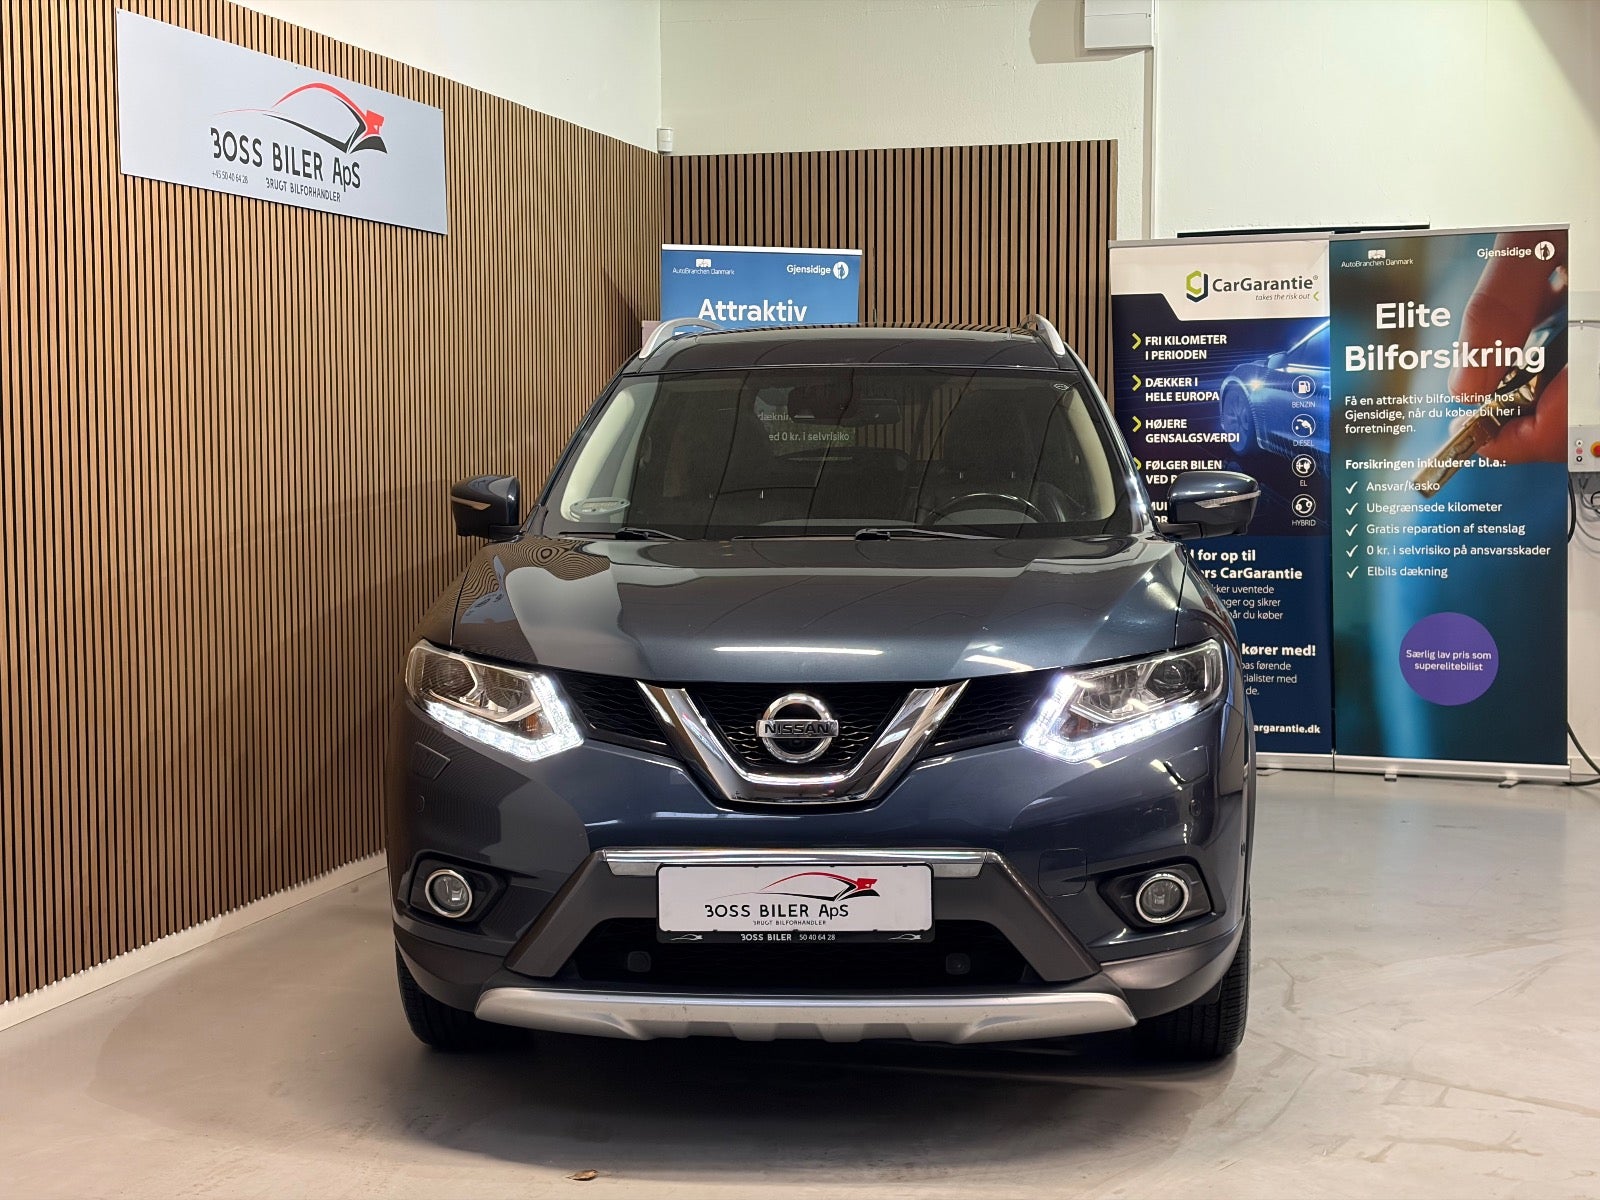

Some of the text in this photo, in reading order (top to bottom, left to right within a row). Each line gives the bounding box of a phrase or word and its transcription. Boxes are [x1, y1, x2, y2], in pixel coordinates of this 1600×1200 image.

[272, 142, 324, 182] BILER
[332, 157, 361, 192] ApS
[290, 183, 341, 202] BILFORHANDLER
[1476, 247, 1532, 260] Gjensidige
[1341, 258, 1414, 268] AutoBranchen Danmark
[672, 267, 734, 276] AutoBranchen Danmark
[786, 265, 831, 276] Gjensidige
[698, 298, 808, 322] Attraktiv
[1376, 301, 1450, 330] Elite
[1145, 334, 1228, 346] FRI KILOMETER
[1145, 350, 1208, 360] I PERIODEN
[1345, 339, 1545, 372] Bilforsikring
[1145, 377, 1198, 388] DÆKKER I
[1145, 391, 1220, 402] HELE EUROPA
[1344, 393, 1515, 406] Få en attraktiv bilforsikring hos
[1292, 401, 1316, 409] BENZIN
[1344, 406, 1521, 422] Gjensidige, når du køber bil her i
[1145, 419, 1188, 430] HØJERE
[1344, 424, 1416, 435] forretningen.
[768, 431, 780, 441] ed
[782, 432, 788, 441] 0
[790, 431, 800, 441] kr.
[808, 431, 850, 441] selvrisiko
[1145, 432, 1240, 444] GENSALGSVÆRDI
[1145, 460, 1222, 470] FØLGER BILEN
[1345, 458, 1506, 471] Forsikringen inkluderer bl.a.:
[1145, 474, 1169, 484] VED
[1366, 480, 1441, 492] Ansvar/kasko
[1366, 502, 1503, 514] Ubegrænsede kilometer
[1366, 524, 1526, 536] Gratis reparation af stenslag
[1366, 545, 1374, 556] 0
[1376, 545, 1390, 556] kr.
[1399, 545, 1450, 556] selvrisiko
[1453, 544, 1467, 557] på
[1470, 545, 1552, 556] ansvarsskader
[1197, 549, 1218, 561] for
[1220, 552, 1238, 564] op
[1241, 549, 1256, 561] til
[1202, 567, 1303, 580] rs CarGarantie
[1367, 566, 1448, 579] Elbils dækning
[1232, 585, 1274, 594] uventede
[1242, 600, 1255, 608] og
[1258, 598, 1281, 607] sikrer
[1242, 610, 1256, 620] du
[1257, 610, 1284, 620] køber
[1241, 643, 1316, 656] kører med!
[1406, 650, 1436, 660] Særlig
[1438, 650, 1450, 659] lav
[1452, 651, 1470, 660] pris
[1256, 661, 1292, 671] førende
[1414, 662, 1483, 671] superelitebilist
[1276, 674, 1298, 684] med
[764, 724, 829, 734] NISSAN
[1253, 724, 1321, 734] argarantie.dk
[759, 904, 809, 918] BILER
[818, 904, 849, 920] ApS
